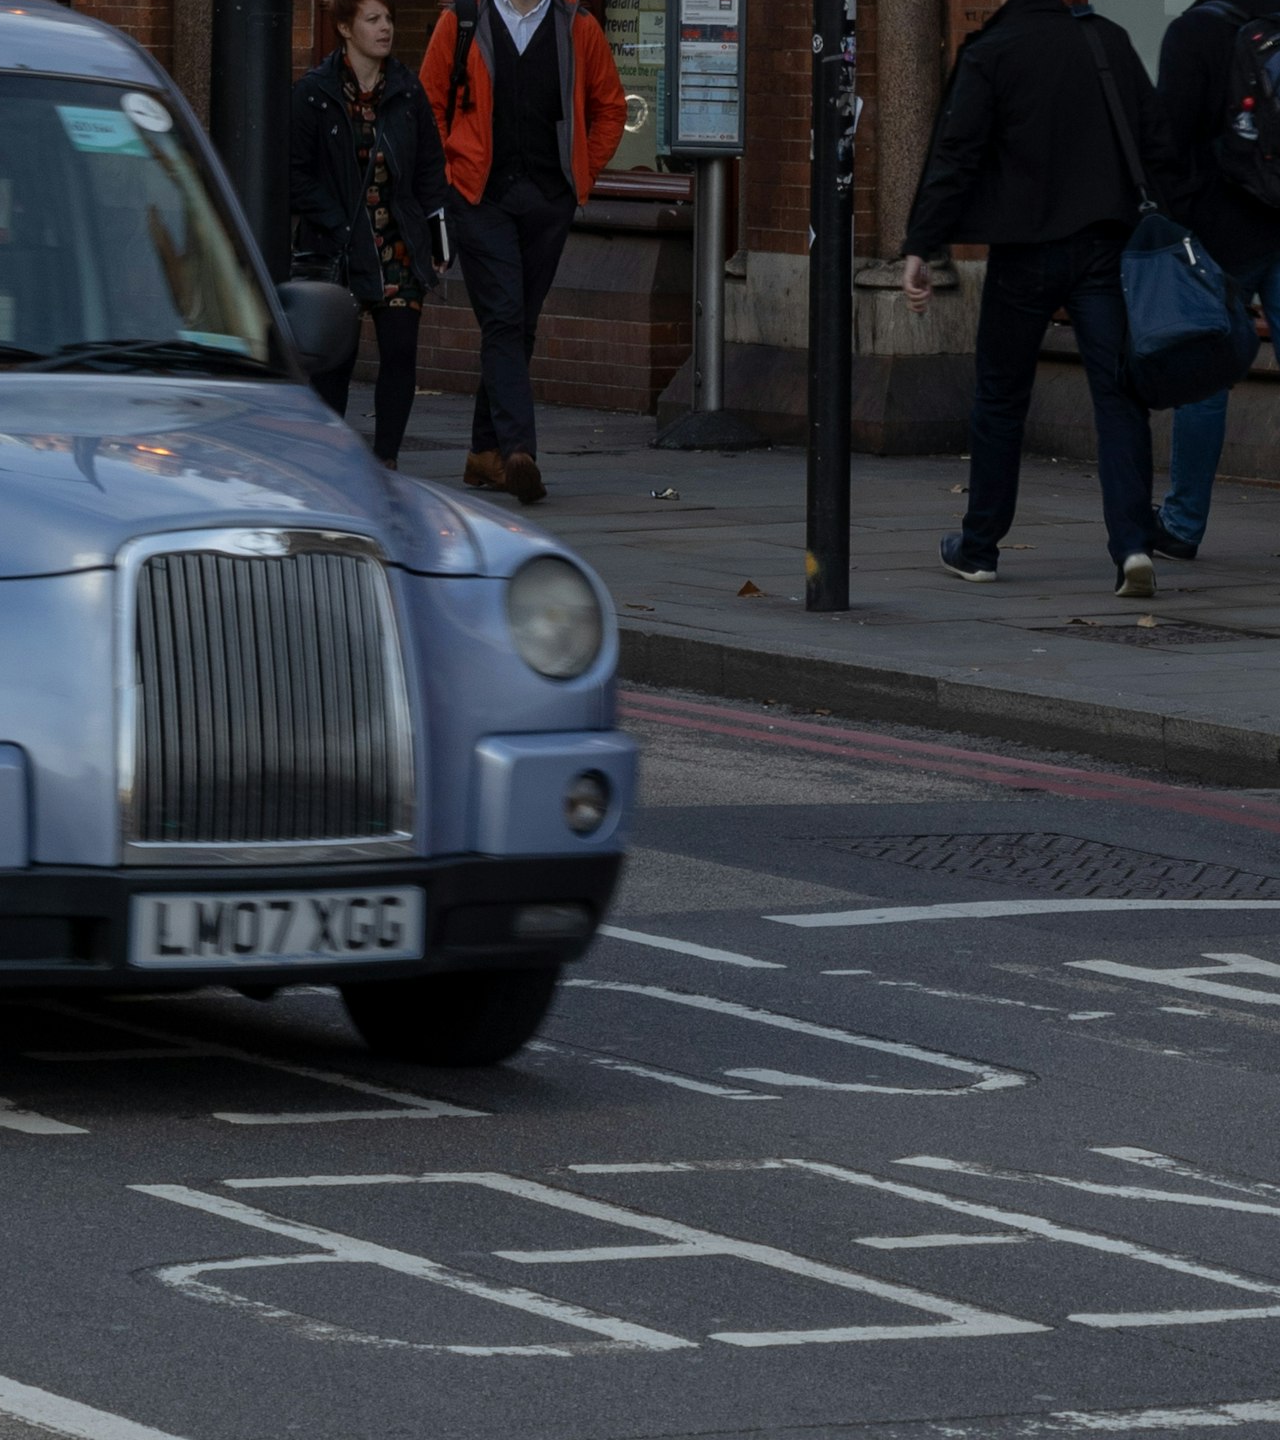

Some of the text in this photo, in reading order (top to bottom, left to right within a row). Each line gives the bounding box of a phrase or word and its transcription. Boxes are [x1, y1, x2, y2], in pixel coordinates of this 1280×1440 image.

[608, 39, 635, 57] ervice
[155, 894, 405, 957] LM07 XGG
